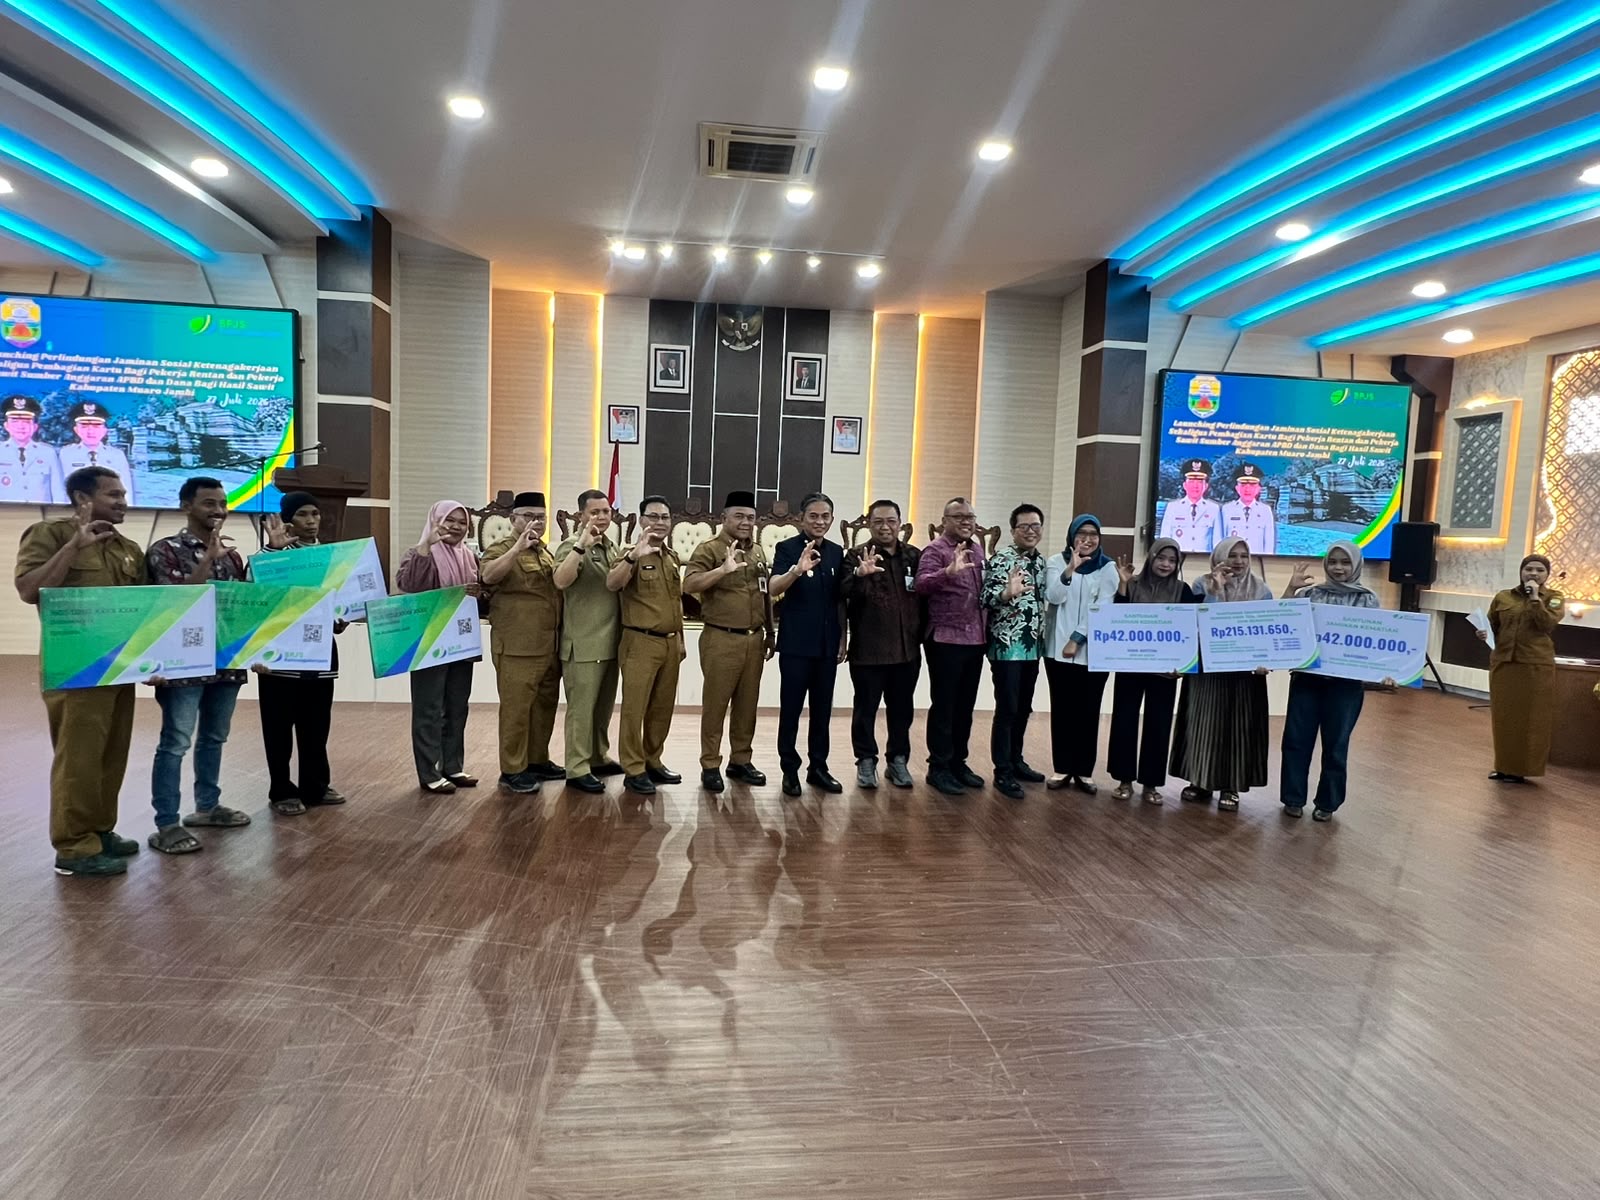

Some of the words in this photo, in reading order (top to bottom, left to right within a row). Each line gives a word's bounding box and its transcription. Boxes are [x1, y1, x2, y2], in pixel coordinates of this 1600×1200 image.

[41, 353, 111, 364] Perlindungan
[112, 357, 158, 366] Jaminan
[160, 360, 192, 368] Sosial
[194, 361, 278, 372] Ketenagakerjaan
[32, 362, 89, 372] Pembagian
[91, 366, 122, 374] Kartu
[124, 367, 147, 377] Bagi
[149, 368, 188, 378] Pekerja
[189, 370, 224, 379] Rentan
[226, 372, 244, 380] dan
[246, 374, 284, 384] Pekerja
[20, 371, 62, 380] Sumber
[63, 374, 114, 384] Anggaran
[116, 376, 144, 384] APBD
[146, 377, 164, 385] dan
[166, 378, 192, 386] Dana
[194, 380, 217, 390] Bagi
[218, 381, 245, 389] Hasil
[246, 382, 276, 391] Sawit
[69, 383, 126, 393] Kabupaten
[127, 386, 162, 394] Muaro
[163, 388, 195, 397] Jambi
[220, 392, 242, 408] Juli
[1173, 420, 1216, 430] Launching
[1216, 422, 1270, 432] Perlindungan
[1270, 425, 1305, 434] Jaminan
[1331, 428, 1396, 438] Ketenagakerjaan
[1168, 428, 1207, 438] Sekaligus
[1208, 430, 1252, 440] Pembagian
[1278, 434, 1296, 442] Bagi
[1297, 434, 1326, 444] Pekerja
[1370, 438, 1399, 447] Pekerja
[1199, 438, 1231, 446] Sumber
[1232, 440, 1271, 449] Anggaran
[1330, 444, 1348, 453] Bagi
[1235, 448, 1278, 456] Kabupaten
[1348, 455, 1366, 468] Juli
[1094, 630, 1190, 644] Rp42.000.000,-
[1211, 624, 1297, 639] Rp215.131.650,-
